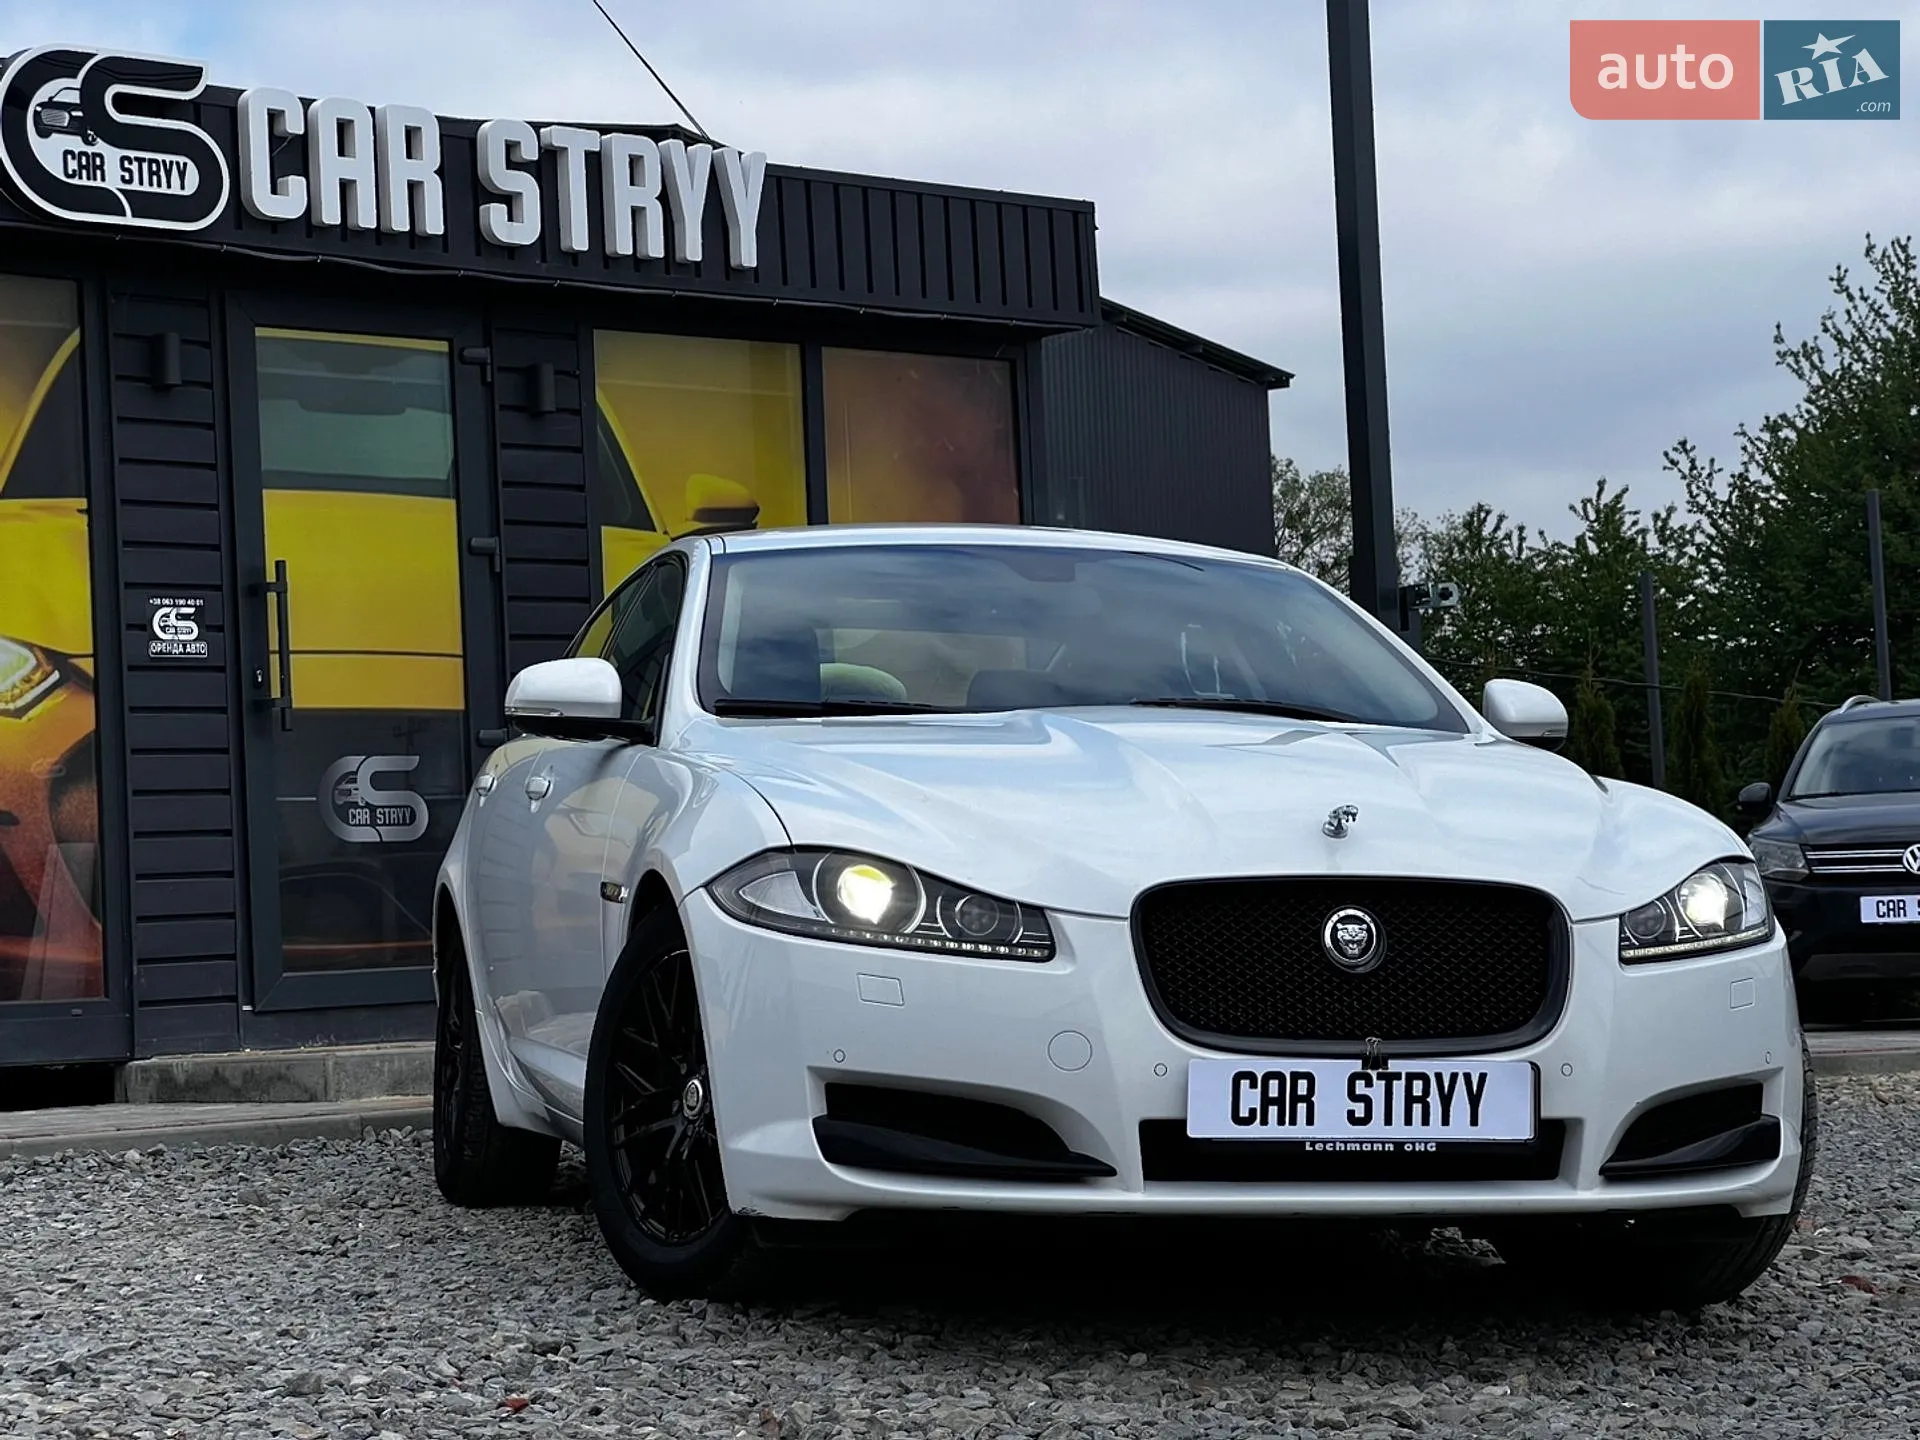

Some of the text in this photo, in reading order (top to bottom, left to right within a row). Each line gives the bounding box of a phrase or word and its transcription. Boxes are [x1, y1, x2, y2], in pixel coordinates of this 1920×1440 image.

[62, 149, 188, 191] CAR STRYY
[238, 87, 766, 270] CAR STRYY
[151, 642, 206, 654] ОРЕНДА АВТО
[348, 807, 411, 825] CAR STRYY
[1876, 899, 1907, 918] CAR
[1231, 1071, 1488, 1127] CAR STRYY
[1305, 1141, 1394, 1151] Lechmann
